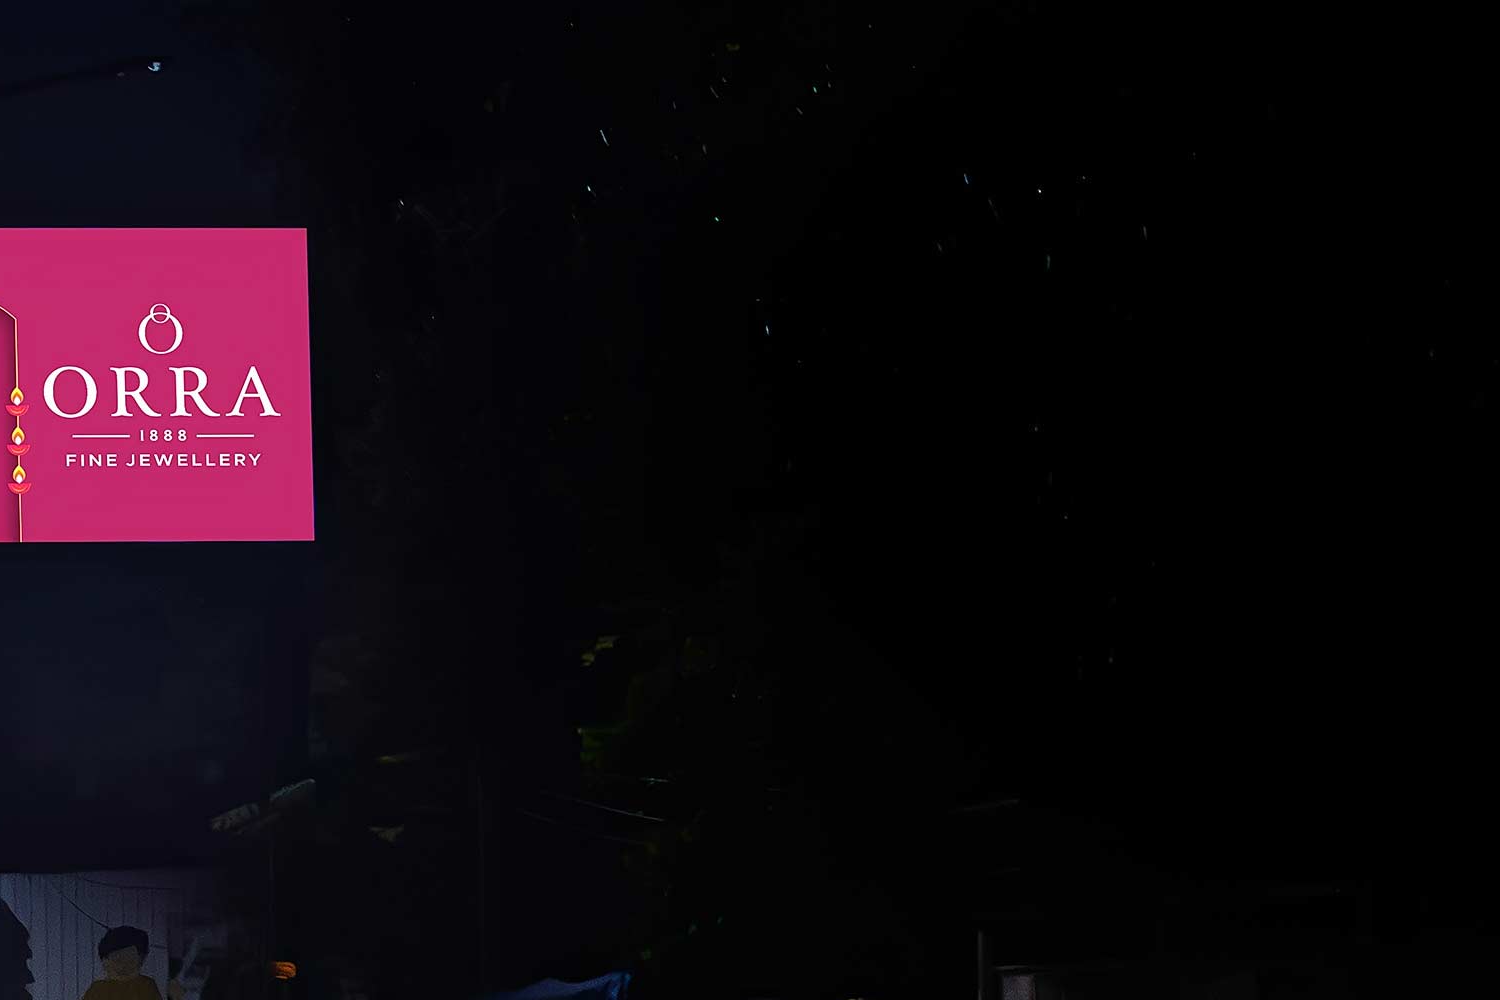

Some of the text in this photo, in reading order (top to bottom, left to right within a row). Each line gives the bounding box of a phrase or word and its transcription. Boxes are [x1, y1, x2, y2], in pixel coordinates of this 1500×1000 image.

[43, 365, 282, 419] ORRA
[139, 429, 188, 442] 1888
[65, 453, 262, 467] FINE JEWELLERY
